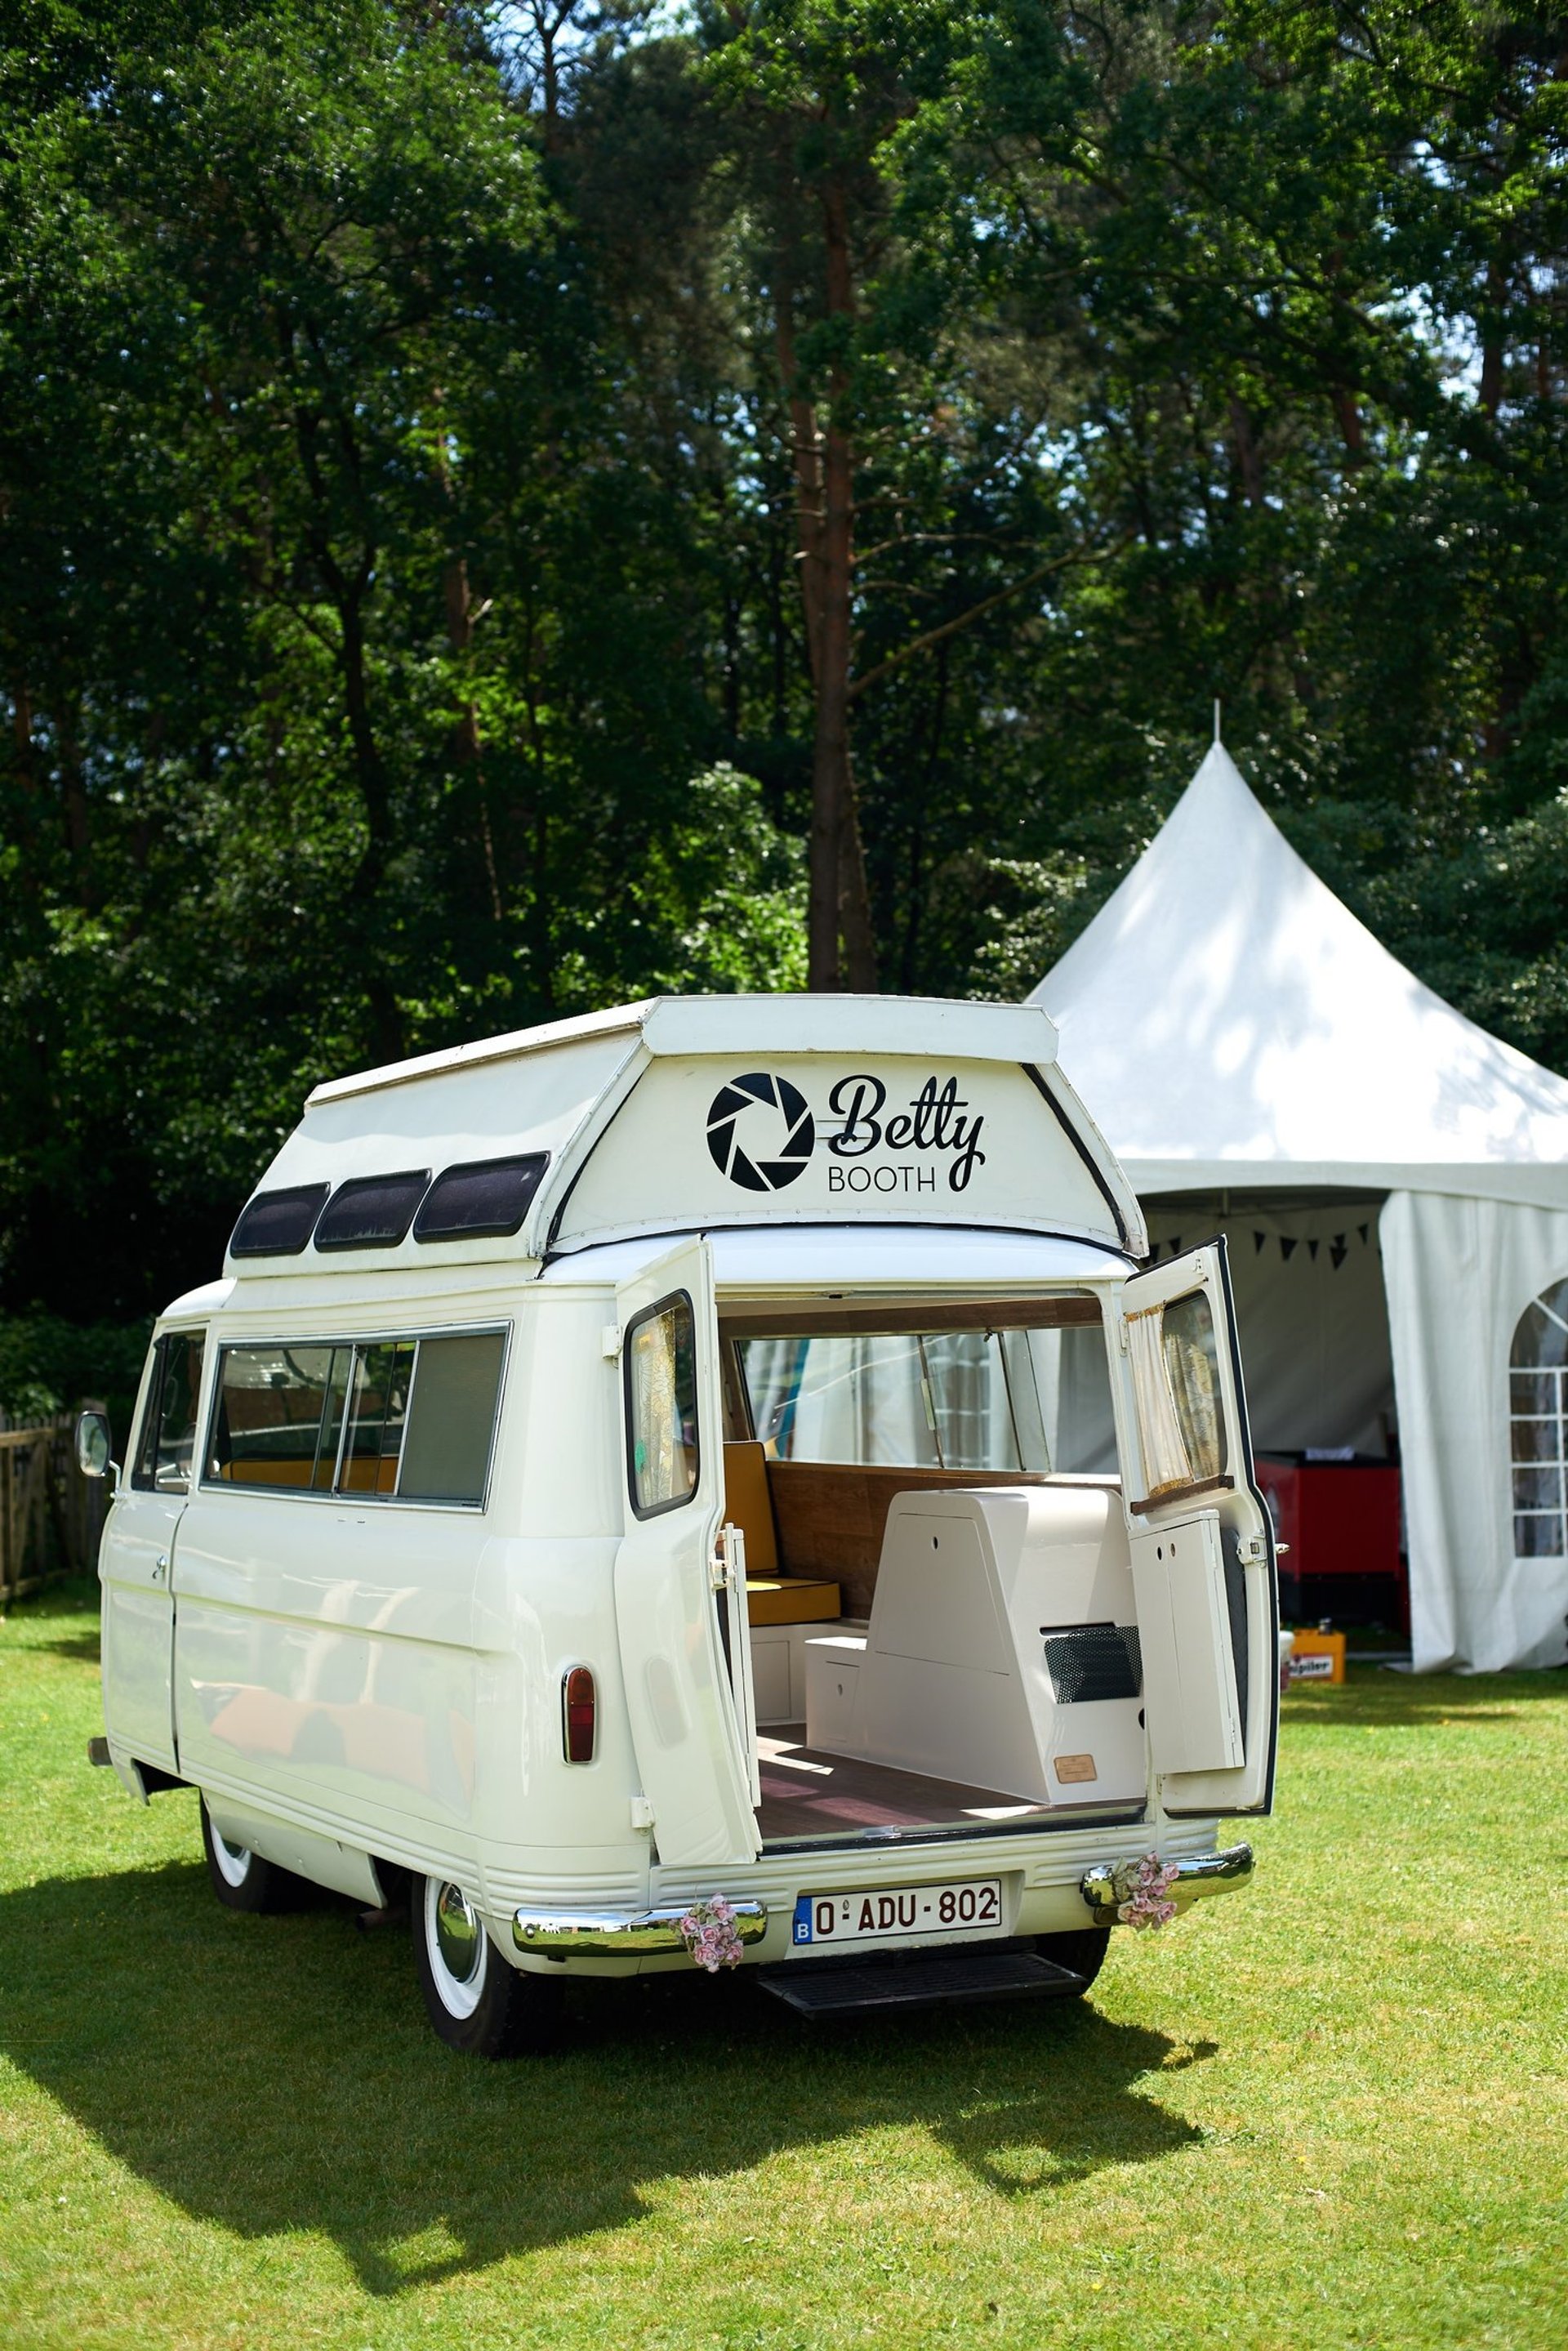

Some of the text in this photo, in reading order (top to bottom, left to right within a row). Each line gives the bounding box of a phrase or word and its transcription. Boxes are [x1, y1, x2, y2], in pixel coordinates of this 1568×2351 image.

[828, 1074, 986, 1192] Betty
[828, 1167, 935, 1192] BOOTH
[1289, 1660, 1330, 1675] upiler
[797, 1923, 810, 1939] B
